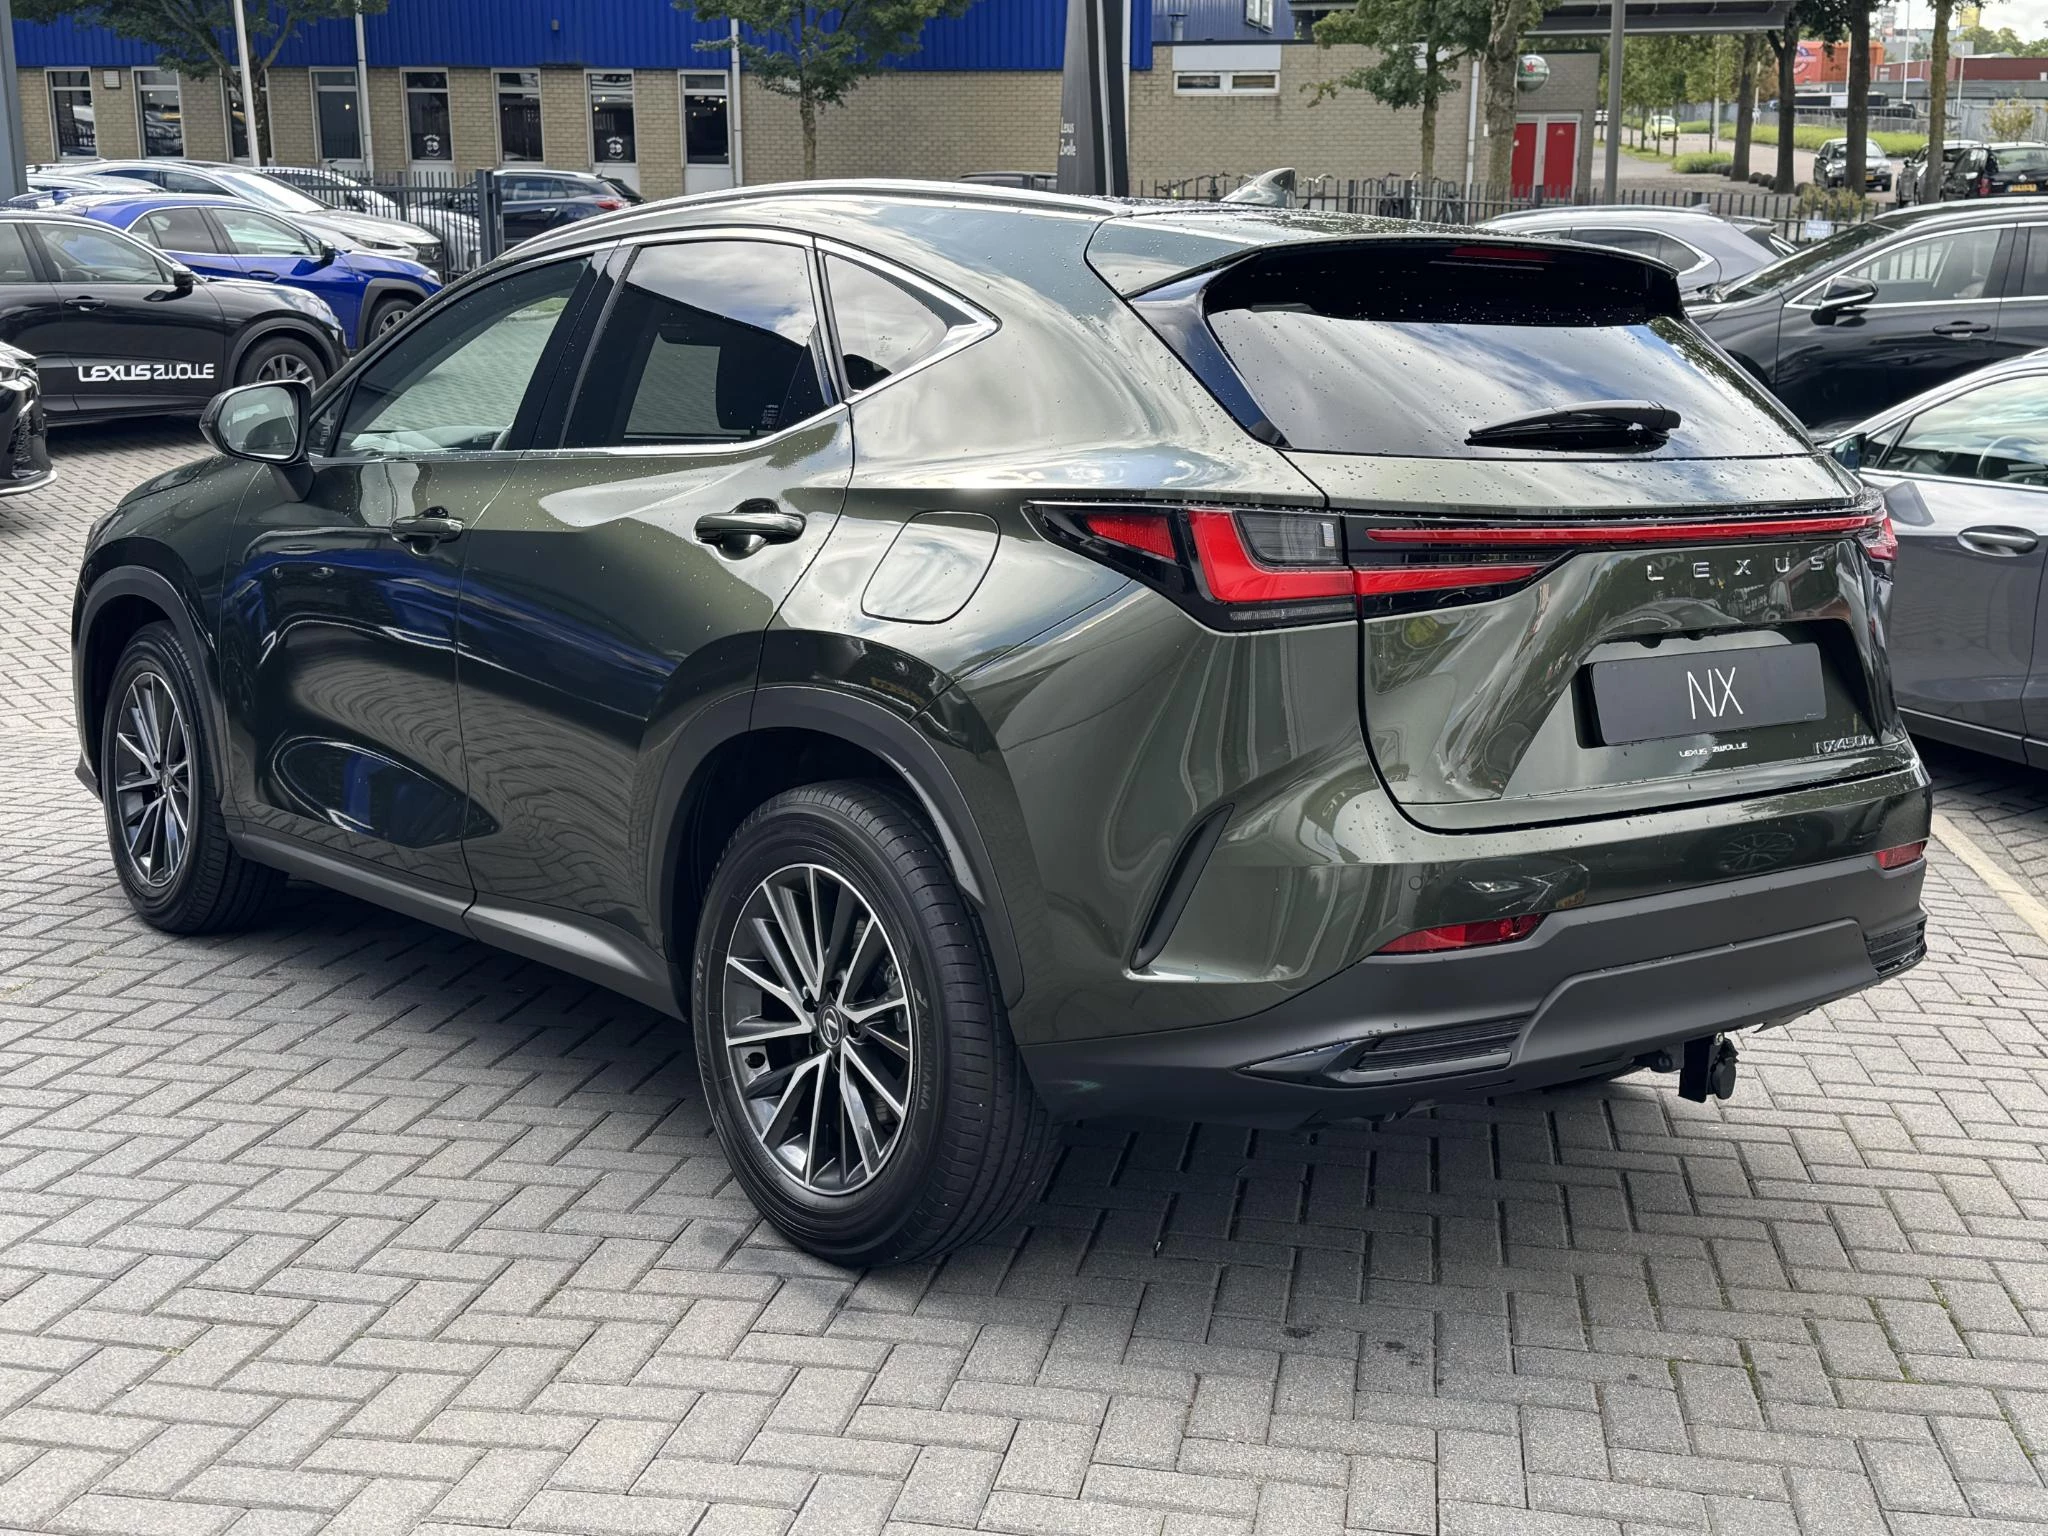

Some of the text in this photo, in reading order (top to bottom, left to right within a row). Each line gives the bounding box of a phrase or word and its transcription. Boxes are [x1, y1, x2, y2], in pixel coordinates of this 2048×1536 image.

[78, 365, 152, 382] LEXUS
[1646, 555, 1825, 581] LEXUS
[1687, 666, 1744, 720] NX
[1679, 741, 1748, 758] LEXUS ZWOLLE
